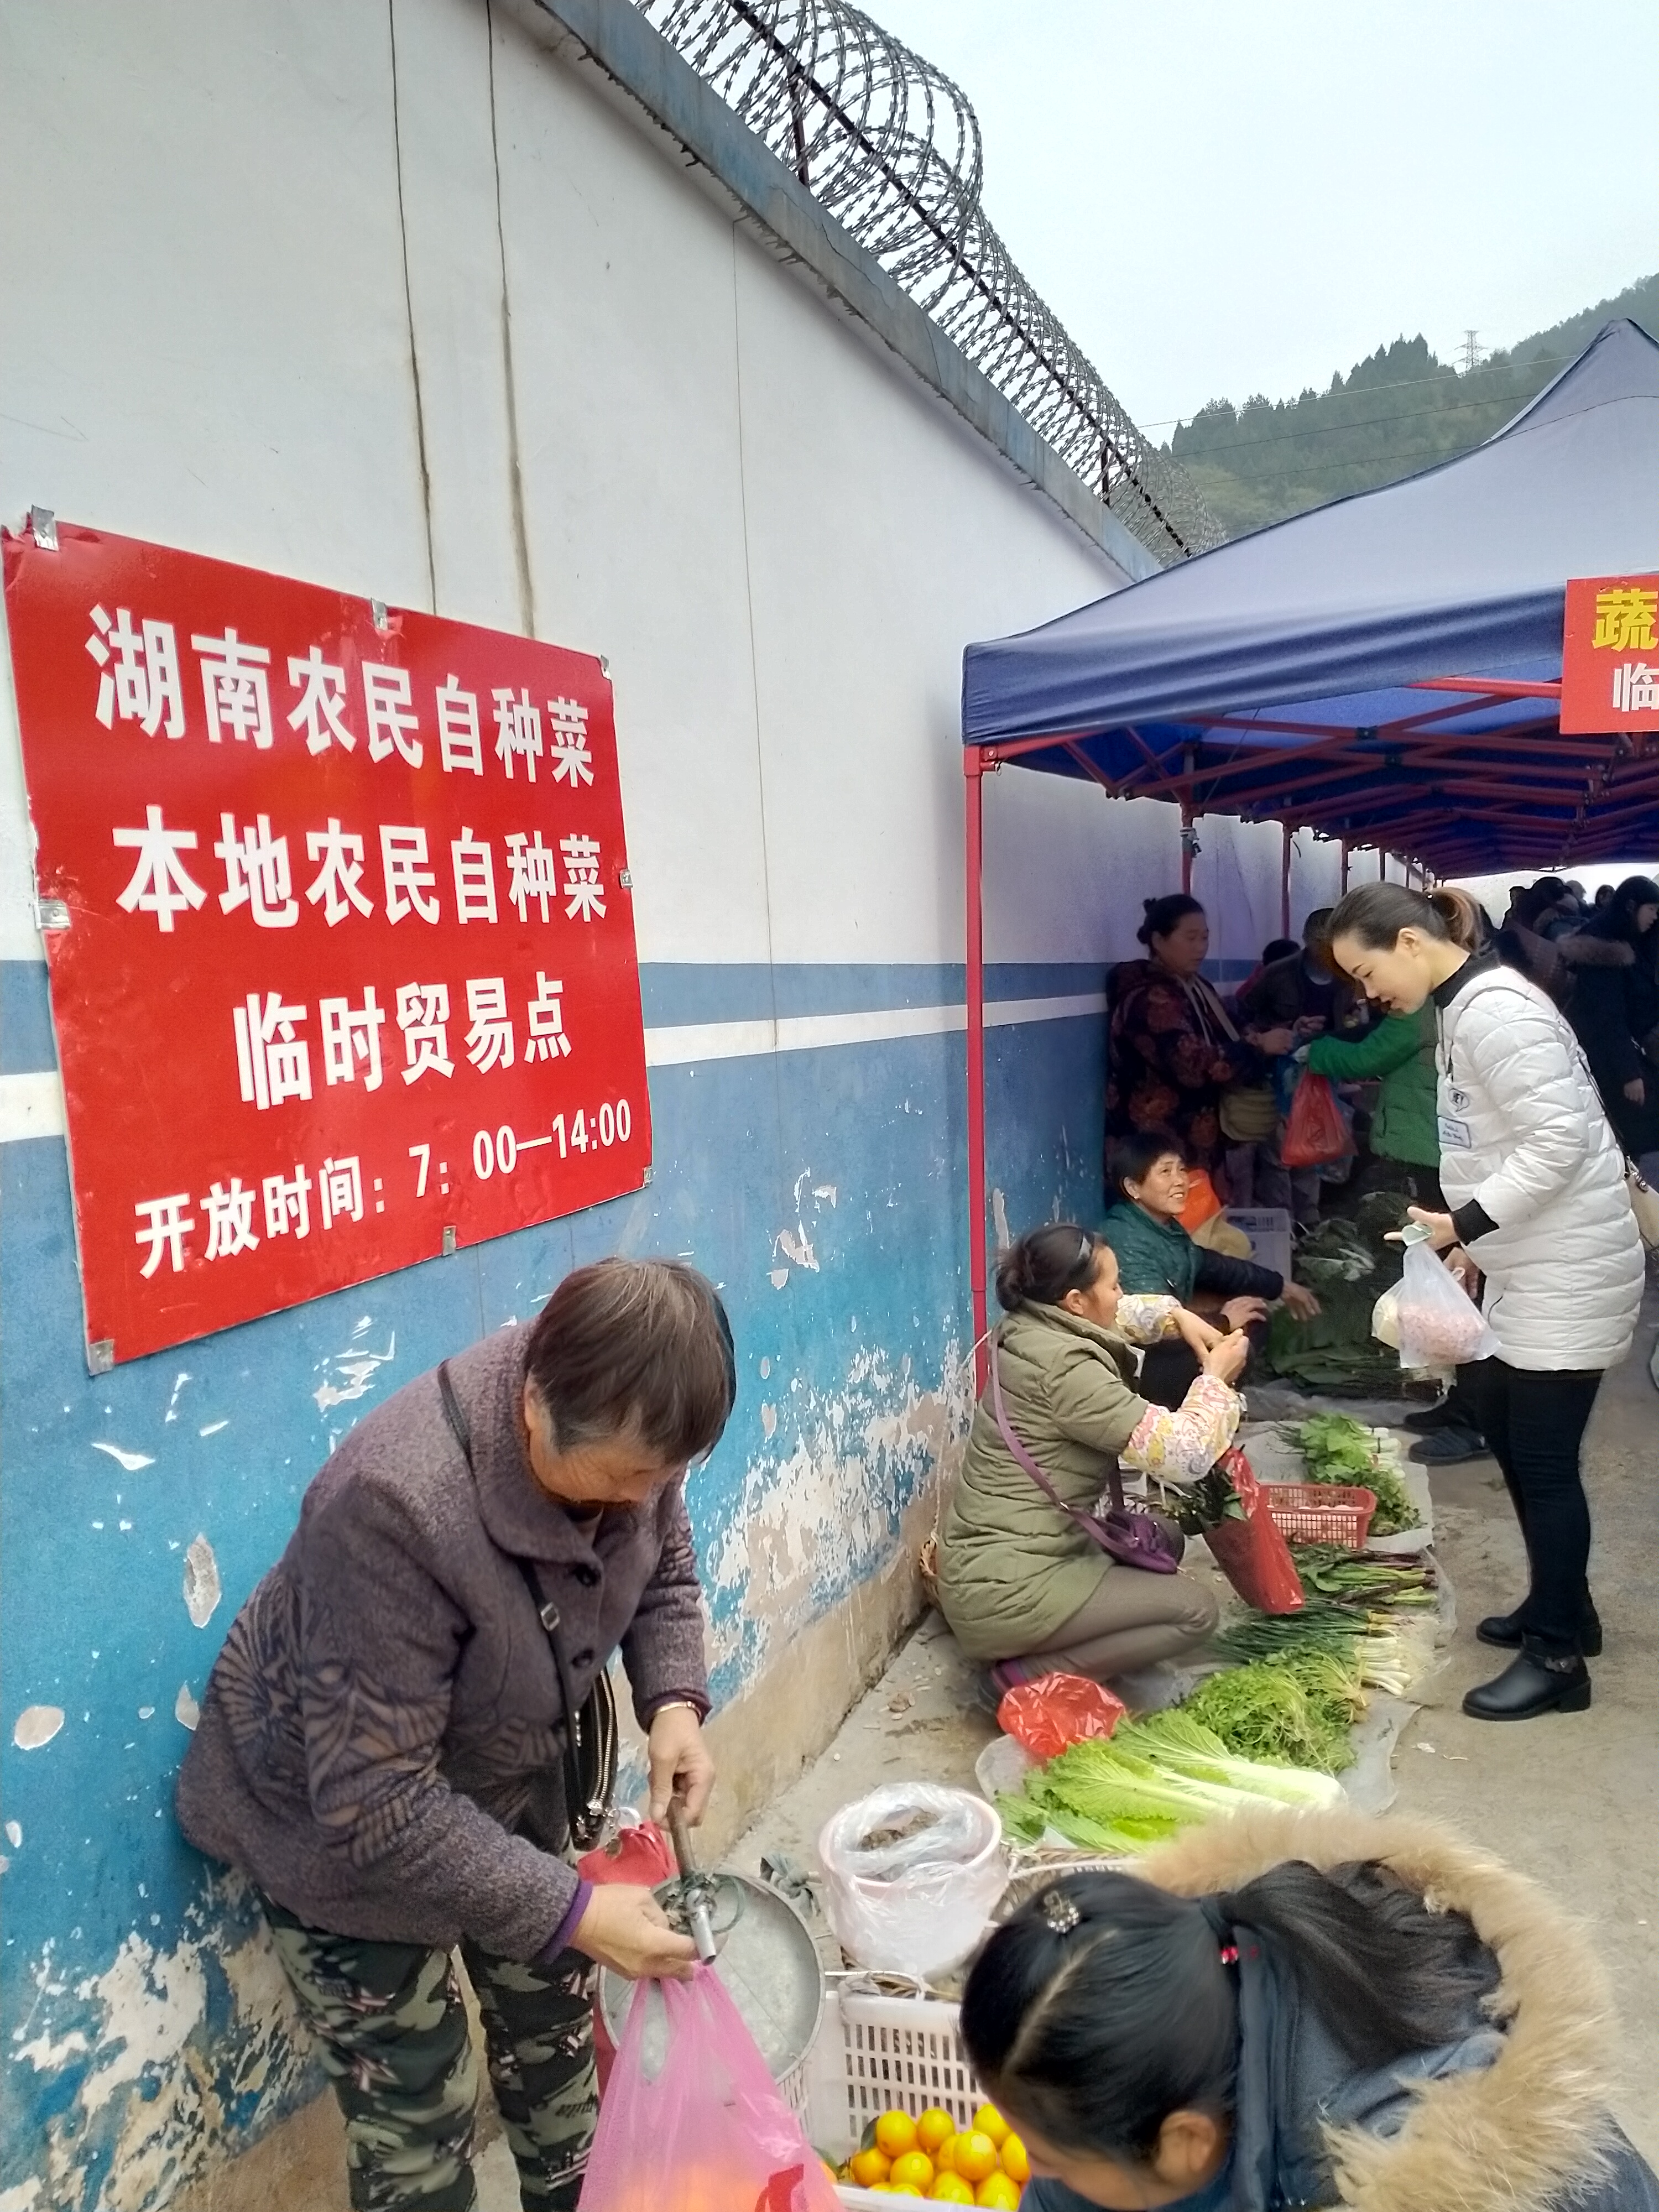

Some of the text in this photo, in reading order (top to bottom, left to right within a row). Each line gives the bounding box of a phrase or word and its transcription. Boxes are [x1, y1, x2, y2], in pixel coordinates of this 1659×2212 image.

[1592, 588, 1659, 651] 蔬
[85, 605, 593, 787] 湖南农民自种菜
[113, 805, 607, 932] 本地农民自种菜
[233, 972, 571, 1110] 临时贸易点
